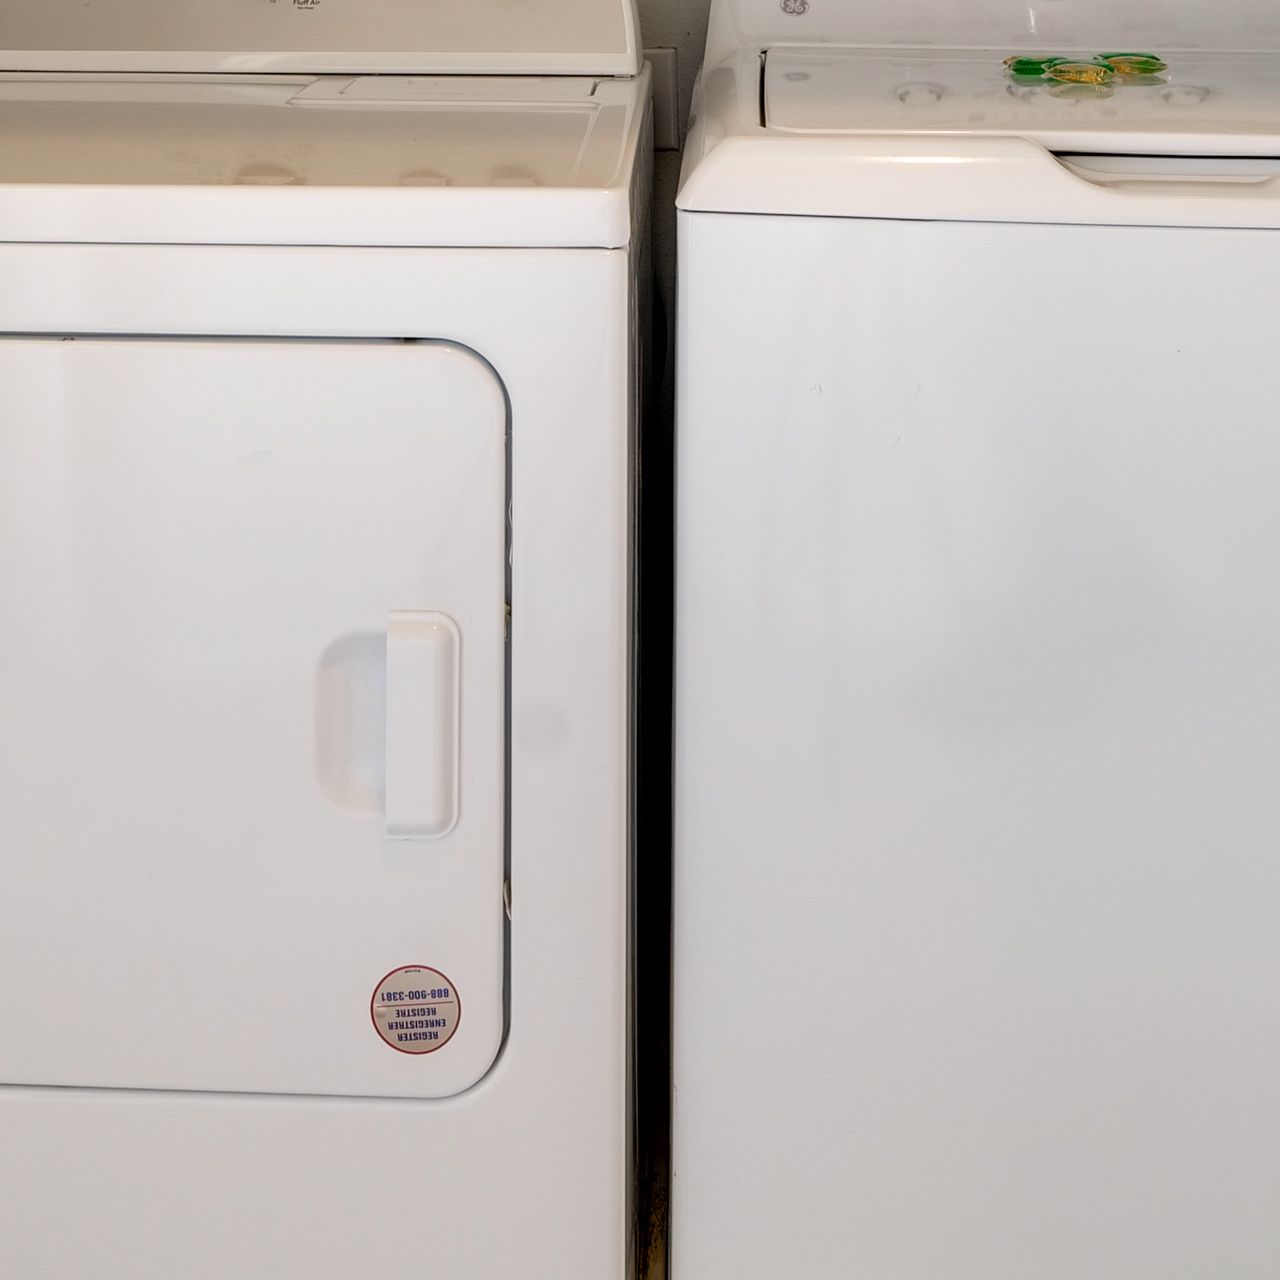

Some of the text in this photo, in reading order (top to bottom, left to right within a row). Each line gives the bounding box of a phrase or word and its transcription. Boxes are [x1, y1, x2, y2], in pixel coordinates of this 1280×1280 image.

[381, 988, 449, 1001] 888-900-3381
[395, 1007, 437, 1018] REGISTRE
[388, 1019, 446, 1030] ENREGISTRER
[397, 1031, 439, 1042] REGISTER
